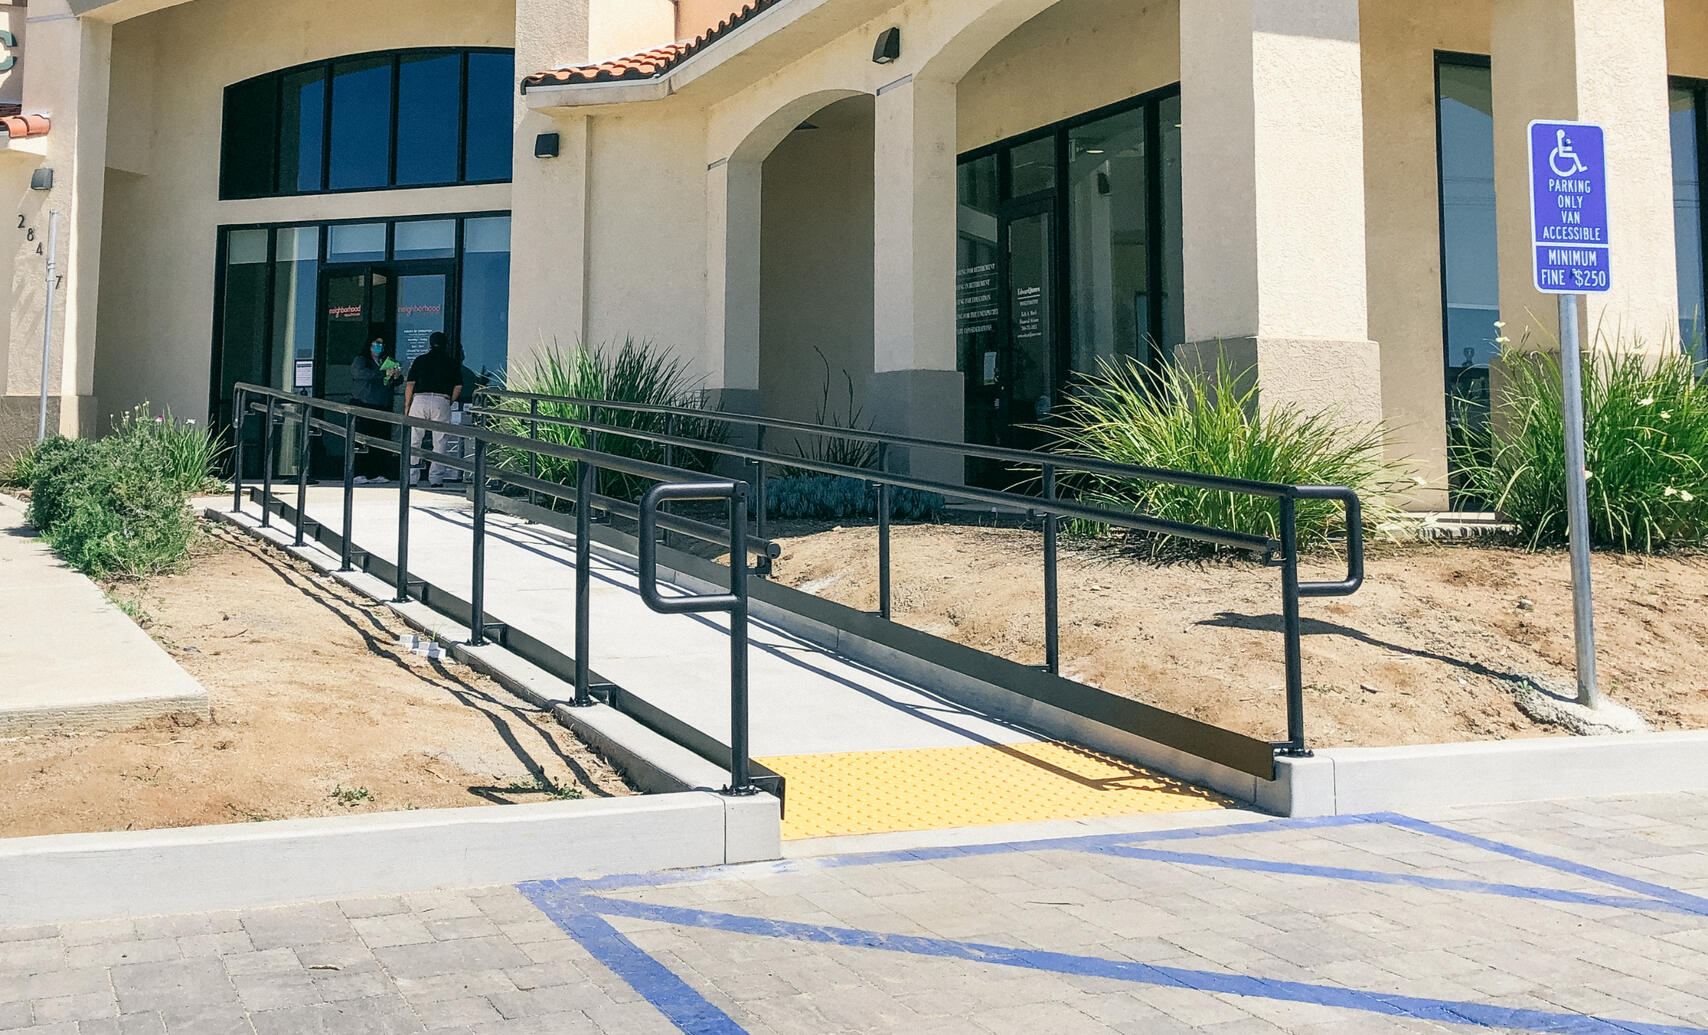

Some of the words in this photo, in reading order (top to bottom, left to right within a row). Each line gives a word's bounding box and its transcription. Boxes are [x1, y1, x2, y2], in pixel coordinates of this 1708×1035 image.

[1549, 179, 1591, 193] PARKING
[1558, 195, 1583, 209] ONLY
[1561, 211, 1581, 225] VAN
[1543, 226, 1601, 241] ACCESSIBLE
[1549, 249, 1597, 267] MINIMUM
[1541, 269, 1566, 286] FINE
[1574, 269, 1606, 287] $250
